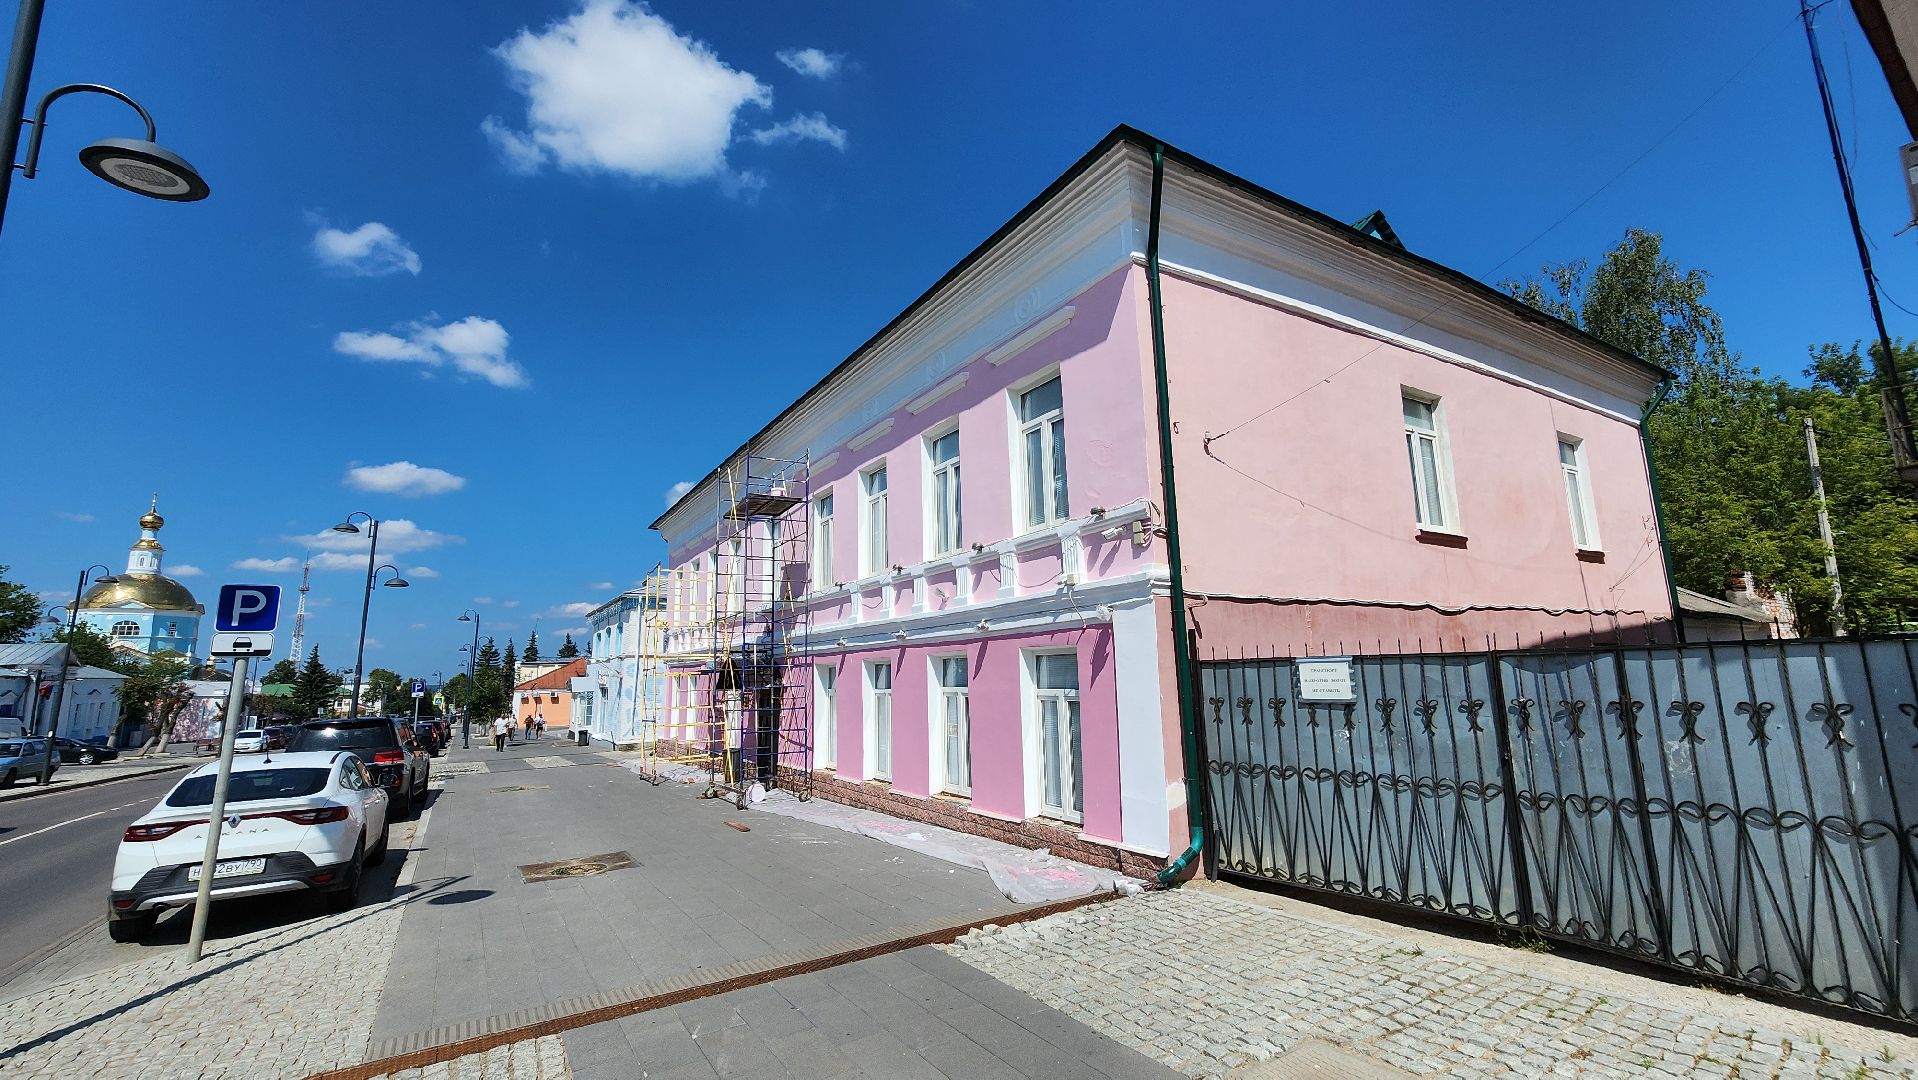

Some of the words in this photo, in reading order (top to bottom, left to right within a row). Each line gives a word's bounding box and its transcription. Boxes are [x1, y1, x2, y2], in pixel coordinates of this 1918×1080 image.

[231, 589, 267, 627] P
[415, 683, 423, 693] P
[194, 828, 269, 840] AKANA
[192, 863, 242, 877] Н2ВУ
